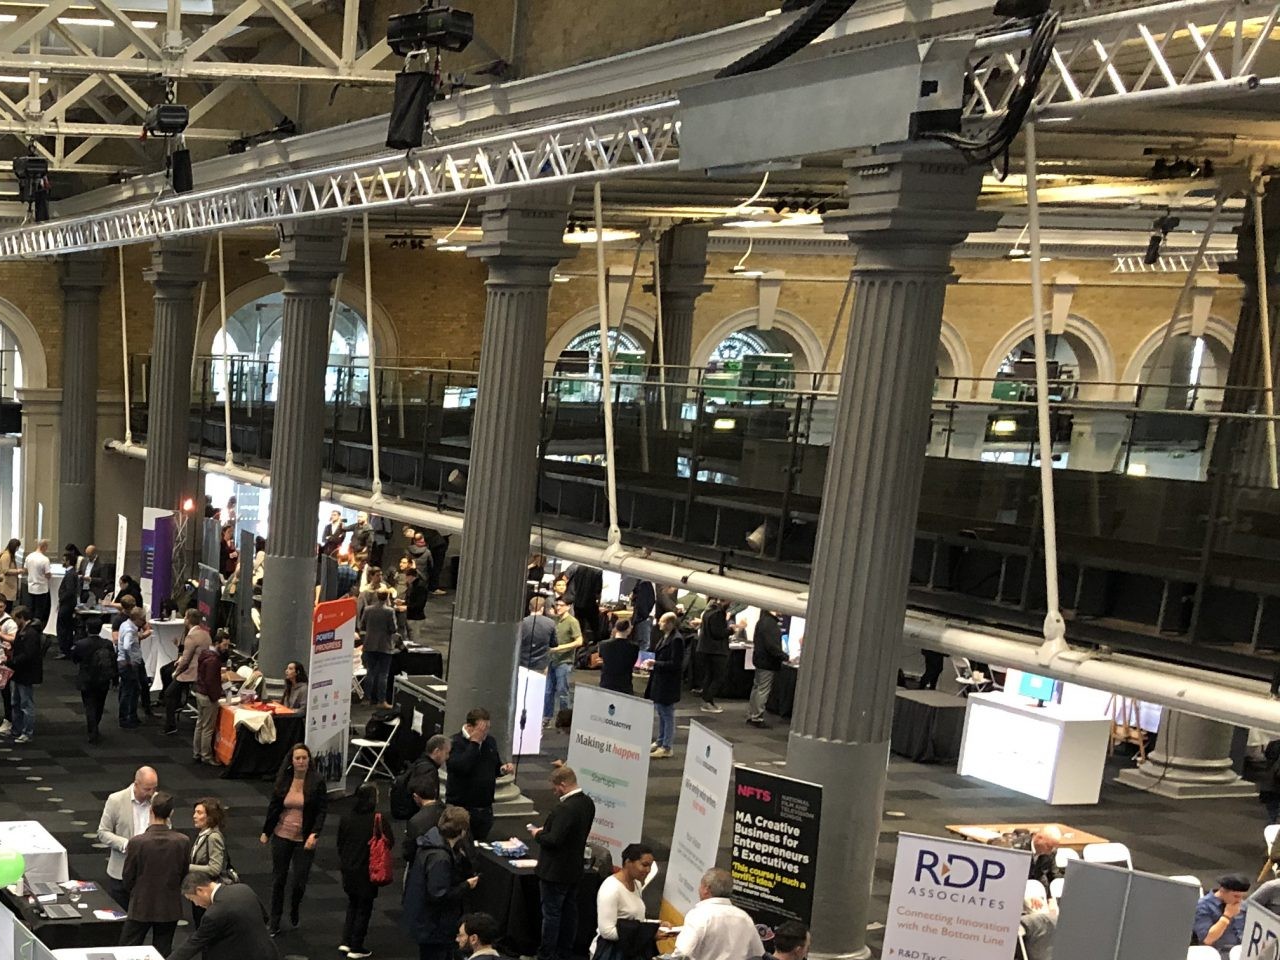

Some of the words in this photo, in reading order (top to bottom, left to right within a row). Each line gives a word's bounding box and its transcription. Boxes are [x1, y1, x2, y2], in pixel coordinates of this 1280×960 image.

[316, 640, 342, 653] PROGRESS
[575, 733, 605, 754] Making
[605, 743, 612, 753] it
[612, 743, 640, 761] happen
[737, 784, 771, 802] NFTS
[735, 810, 752, 825] MA
[754, 815, 801, 837] Creative
[735, 823, 781, 844] Business
[782, 835, 799, 849] for
[733, 834, 810, 864] Entrepreneurs
[733, 846, 739, 857] &
[741, 849, 799, 874] Executives
[732, 870, 755, 882] terrific
[749, 867, 775, 880] course
[775, 872, 782, 881] is
[782, 876, 800, 887] such
[799, 881, 807, 889] a
[914, 849, 1006, 893] RDP
[908, 886, 1006, 910] ASSOCIATES
[896, 905, 953, 926] Connecting
[956, 916, 1010, 934] Innovation
[897, 921, 918, 932] with
[922, 924, 939, 935] the
[941, 927, 980, 942] Bottom
[983, 935, 1005, 946] Line
[898, 949, 920, 959] R&D
